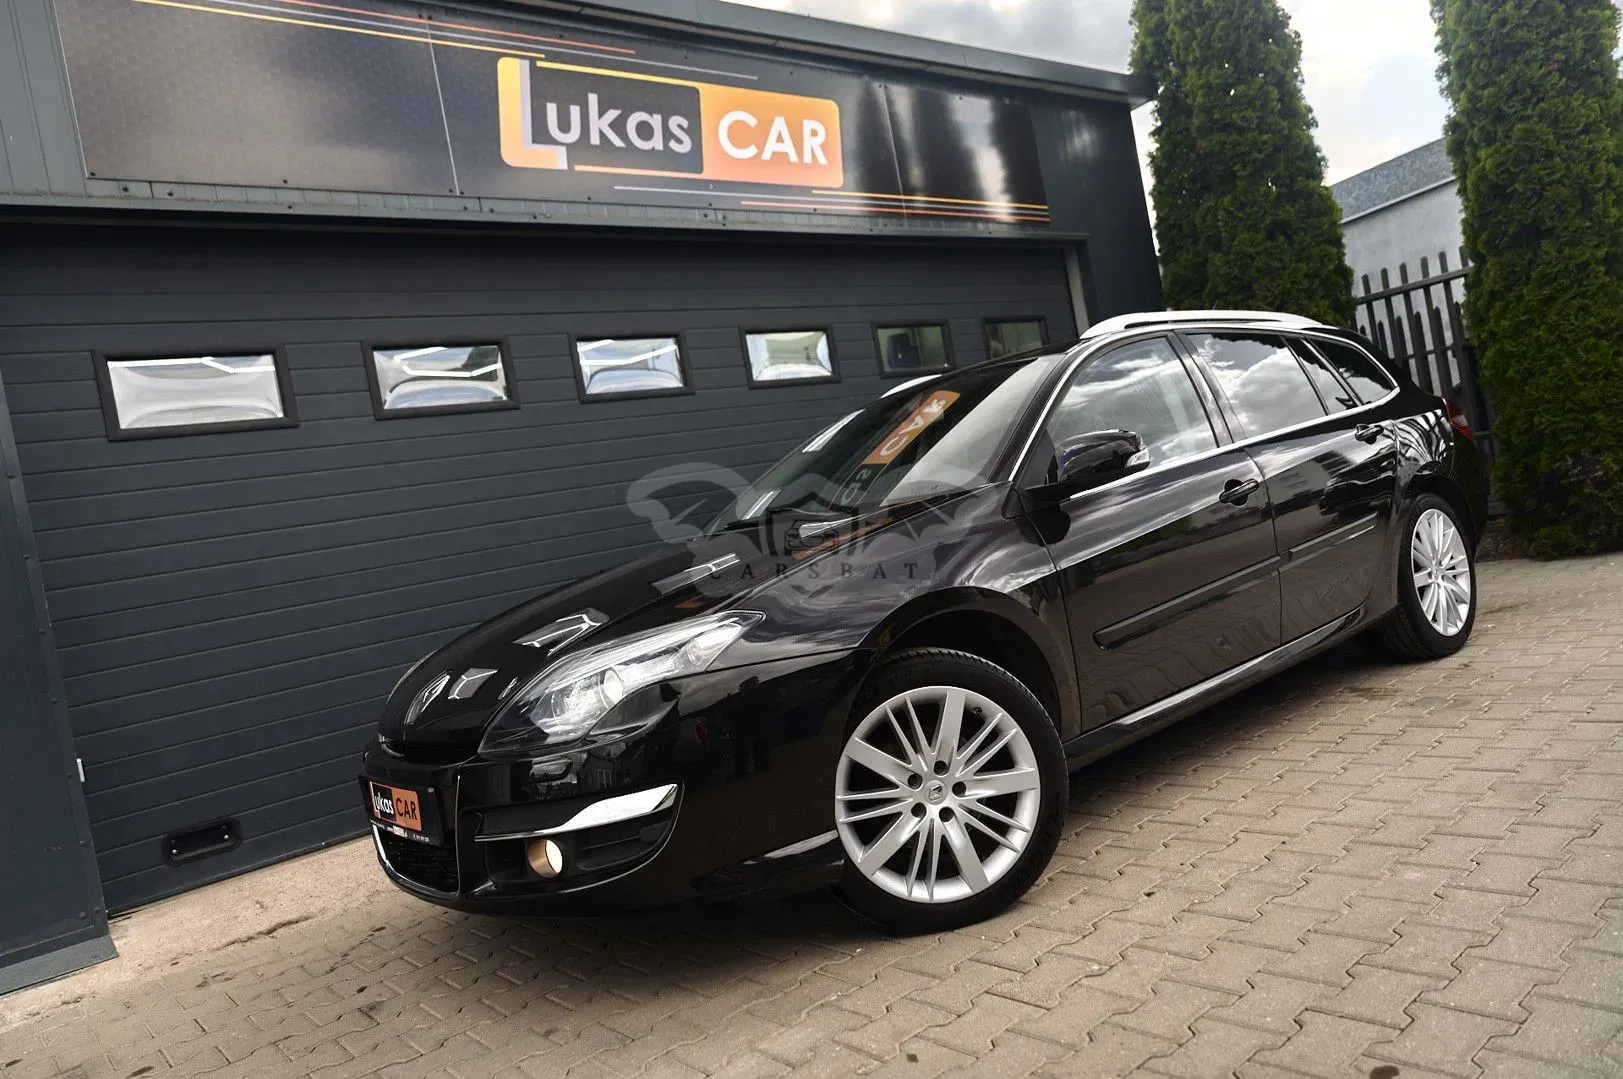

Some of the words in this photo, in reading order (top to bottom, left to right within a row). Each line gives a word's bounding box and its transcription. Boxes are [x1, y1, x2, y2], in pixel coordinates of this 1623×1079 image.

[497, 56, 693, 170] Lukas
[717, 110, 828, 165] CAR
[395, 797, 418, 821] CAR
